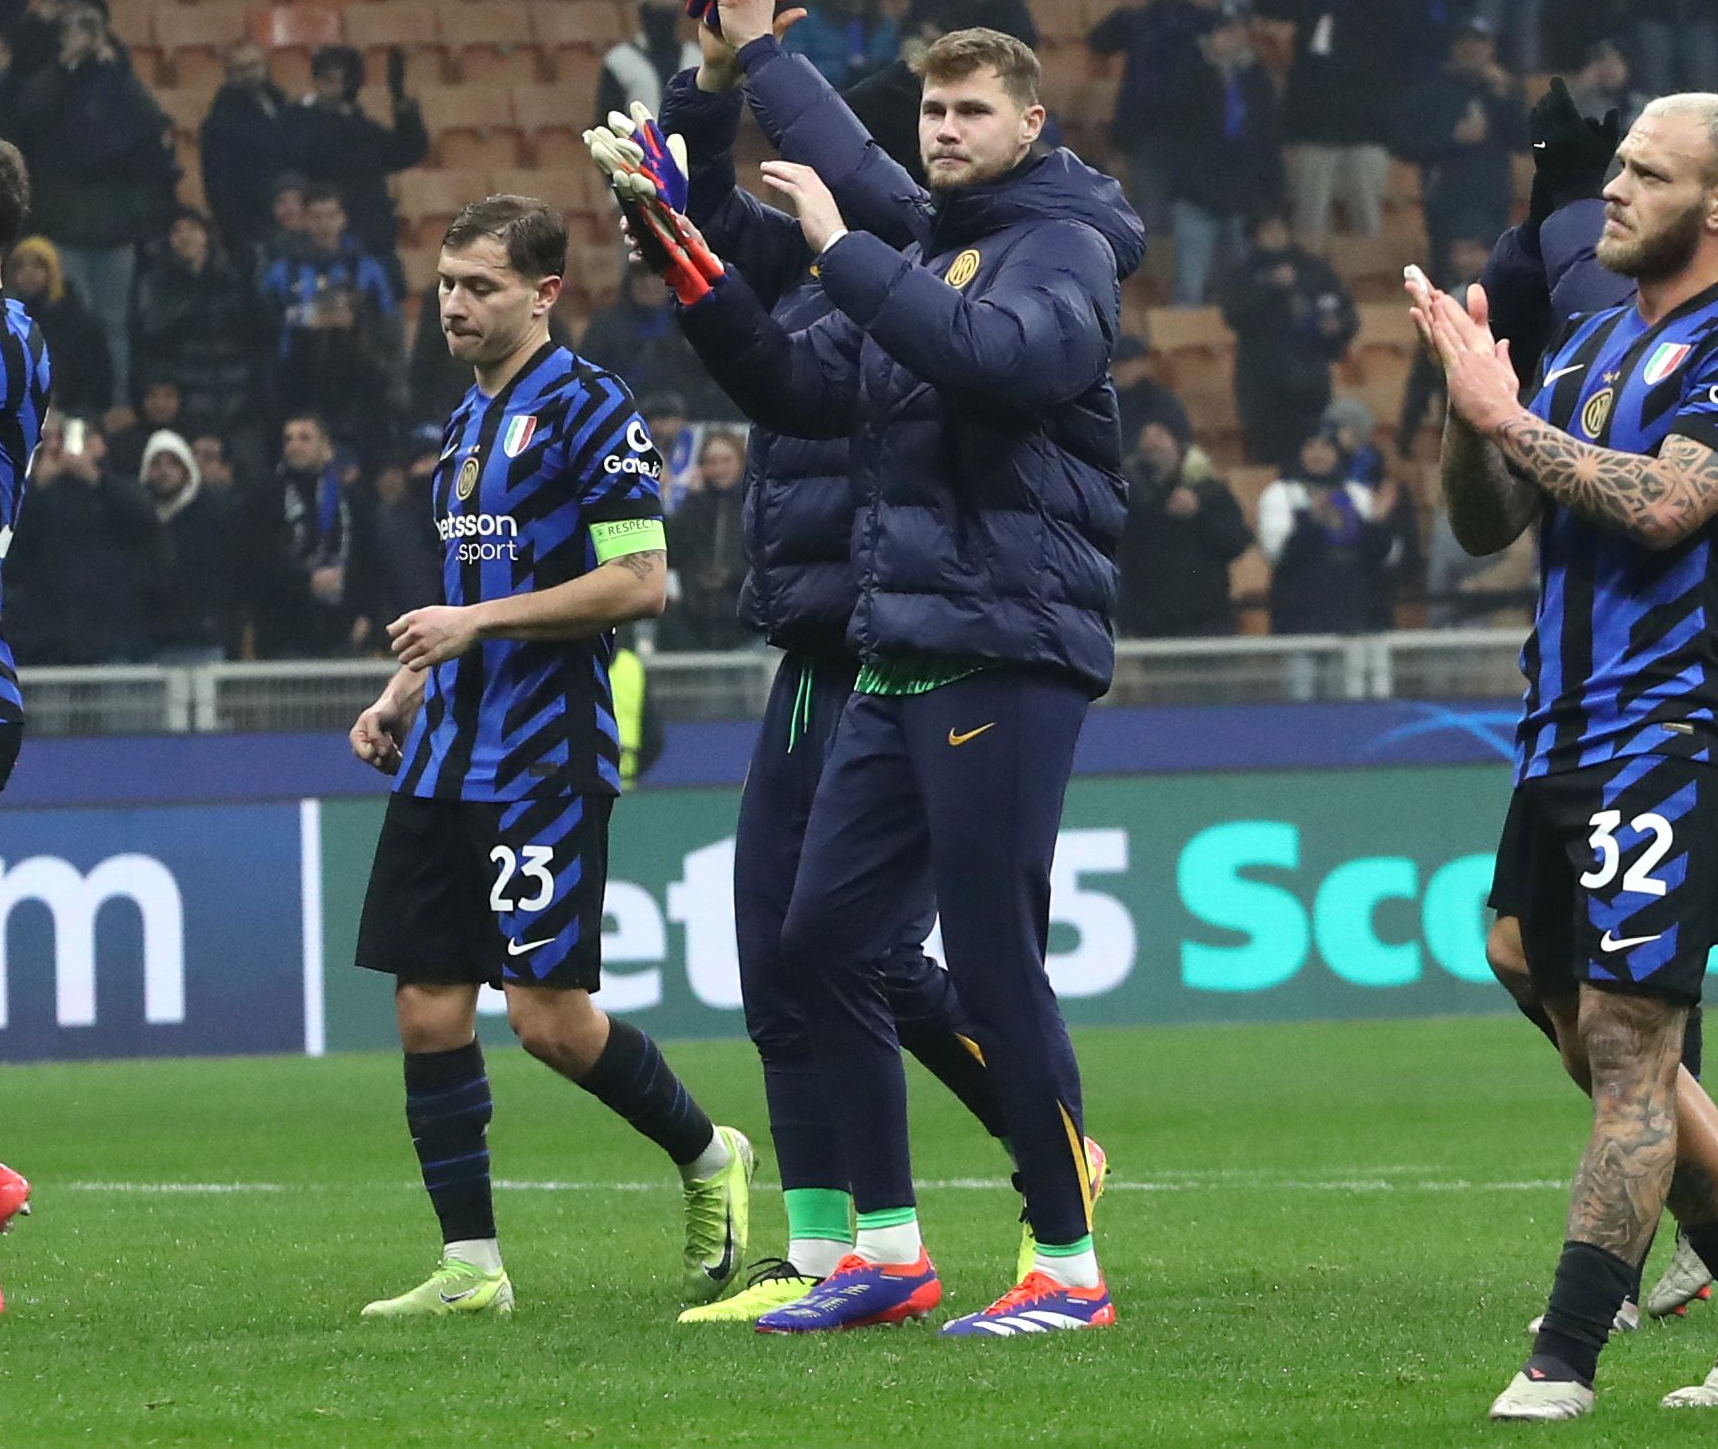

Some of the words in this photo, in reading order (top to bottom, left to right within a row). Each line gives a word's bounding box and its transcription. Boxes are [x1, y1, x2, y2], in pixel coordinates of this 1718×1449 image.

[455, 539, 519, 565] .sport
[489, 844, 555, 912] 23
[1579, 810, 1675, 897] 32
